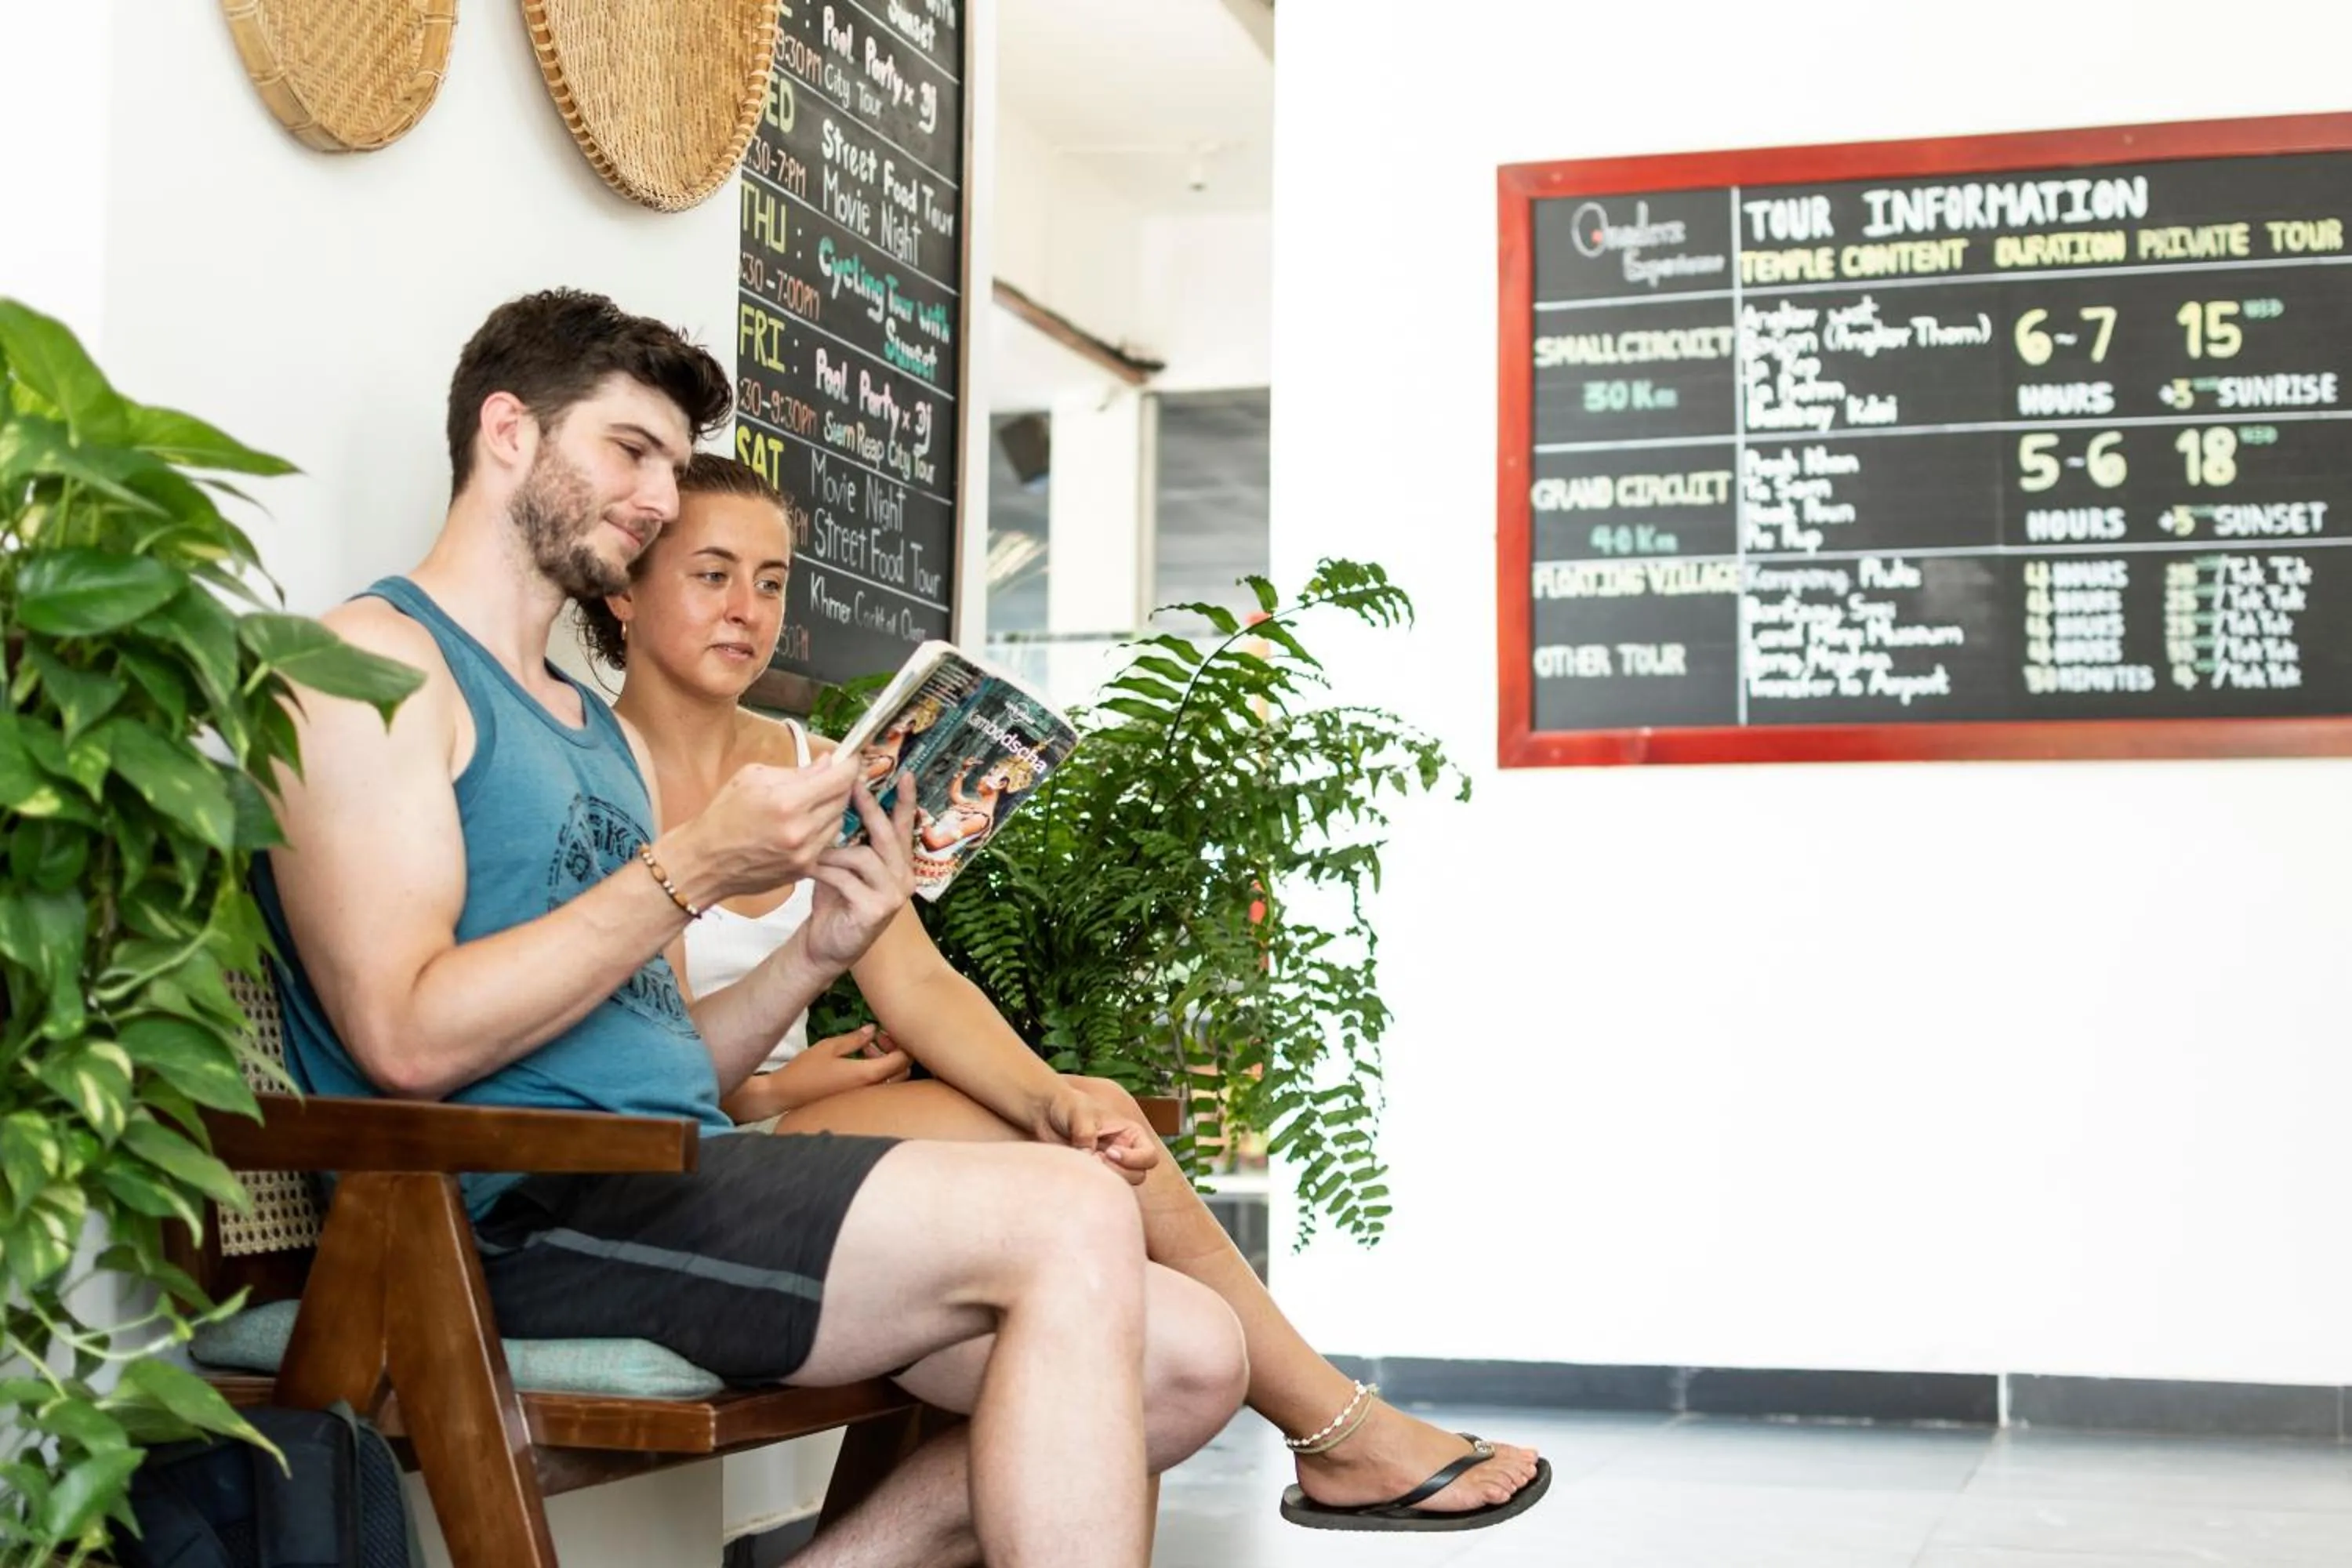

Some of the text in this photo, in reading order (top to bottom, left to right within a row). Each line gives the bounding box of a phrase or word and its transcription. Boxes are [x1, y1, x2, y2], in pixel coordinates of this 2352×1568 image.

[823, 5, 855, 64] Pool
[865, 36, 903, 107] Party
[765, 71, 795, 132] ED
[824, 64, 882, 119] City Tour
[822, 118, 954, 237] Street Food Tour
[823, 164, 922, 267] Movie Night
[1743, 175, 2149, 242] TOUR INFORMATION
[818, 237, 884, 324] Cycling
[1740, 218, 2344, 284] TEMPLE CONTENT DURATION PRIVATE TOUR
[2176, 299, 2242, 359] 15
[816, 348, 849, 405] Pool
[860, 369, 900, 441] Party
[2017, 381, 2115, 416] HOURS
[2217, 372, 2338, 408] SUNRISE
[2174, 426, 2238, 486] 18
[811, 447, 906, 532] Movie Night
[1532, 470, 1733, 510] GRAND CIRCUIT
[2214, 501, 2328, 536] SUNSET
[815, 507, 941, 599] Street Food Tour
[2026, 506, 2127, 542] HOURS
[811, 572, 851, 624] Khmer
[1534, 643, 1686, 679] OTHER TOUR
